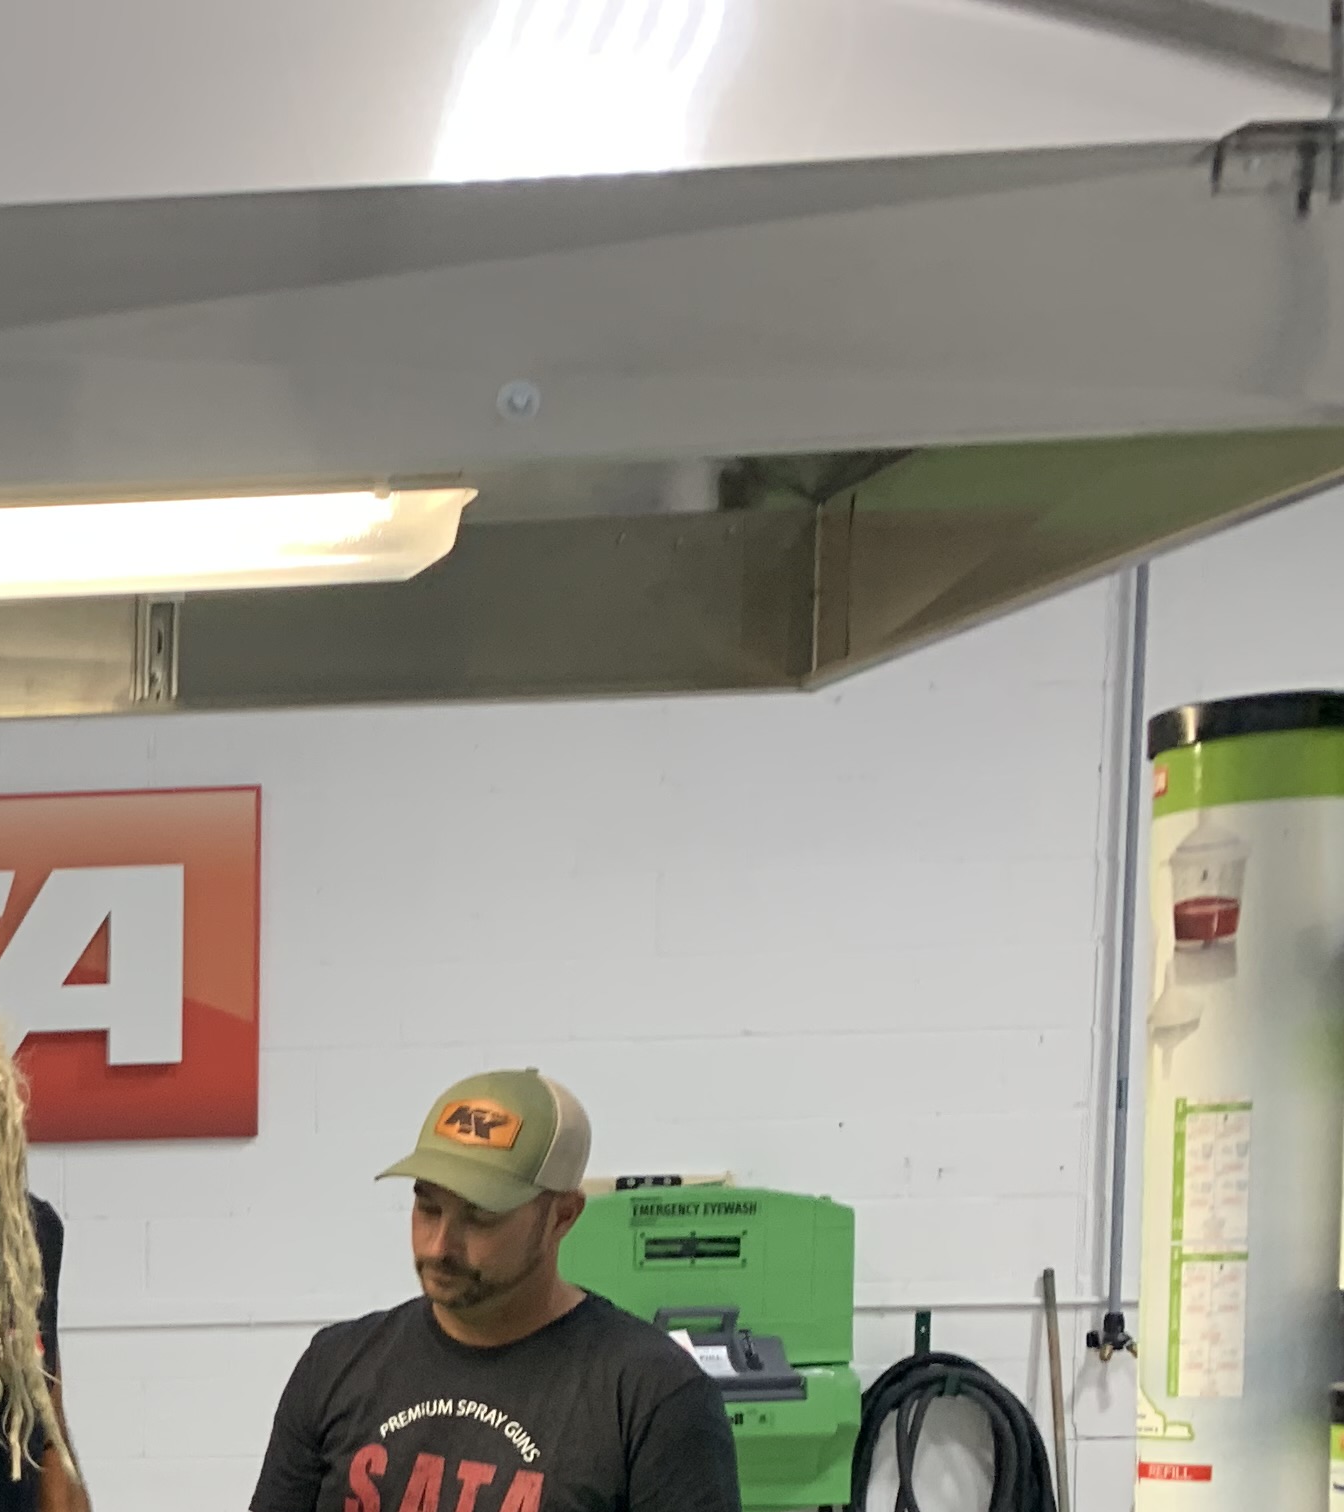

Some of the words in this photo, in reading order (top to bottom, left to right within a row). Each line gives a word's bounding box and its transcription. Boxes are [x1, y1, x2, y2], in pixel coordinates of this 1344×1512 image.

[633, 1203, 700, 1216] EMERGENCY
[703, 1201, 758, 1216] EYEWASH
[380, 1399, 453, 1438] PREMIUM
[456, 1399, 508, 1429] SPRAY
[504, 1421, 540, 1463] GUNS
